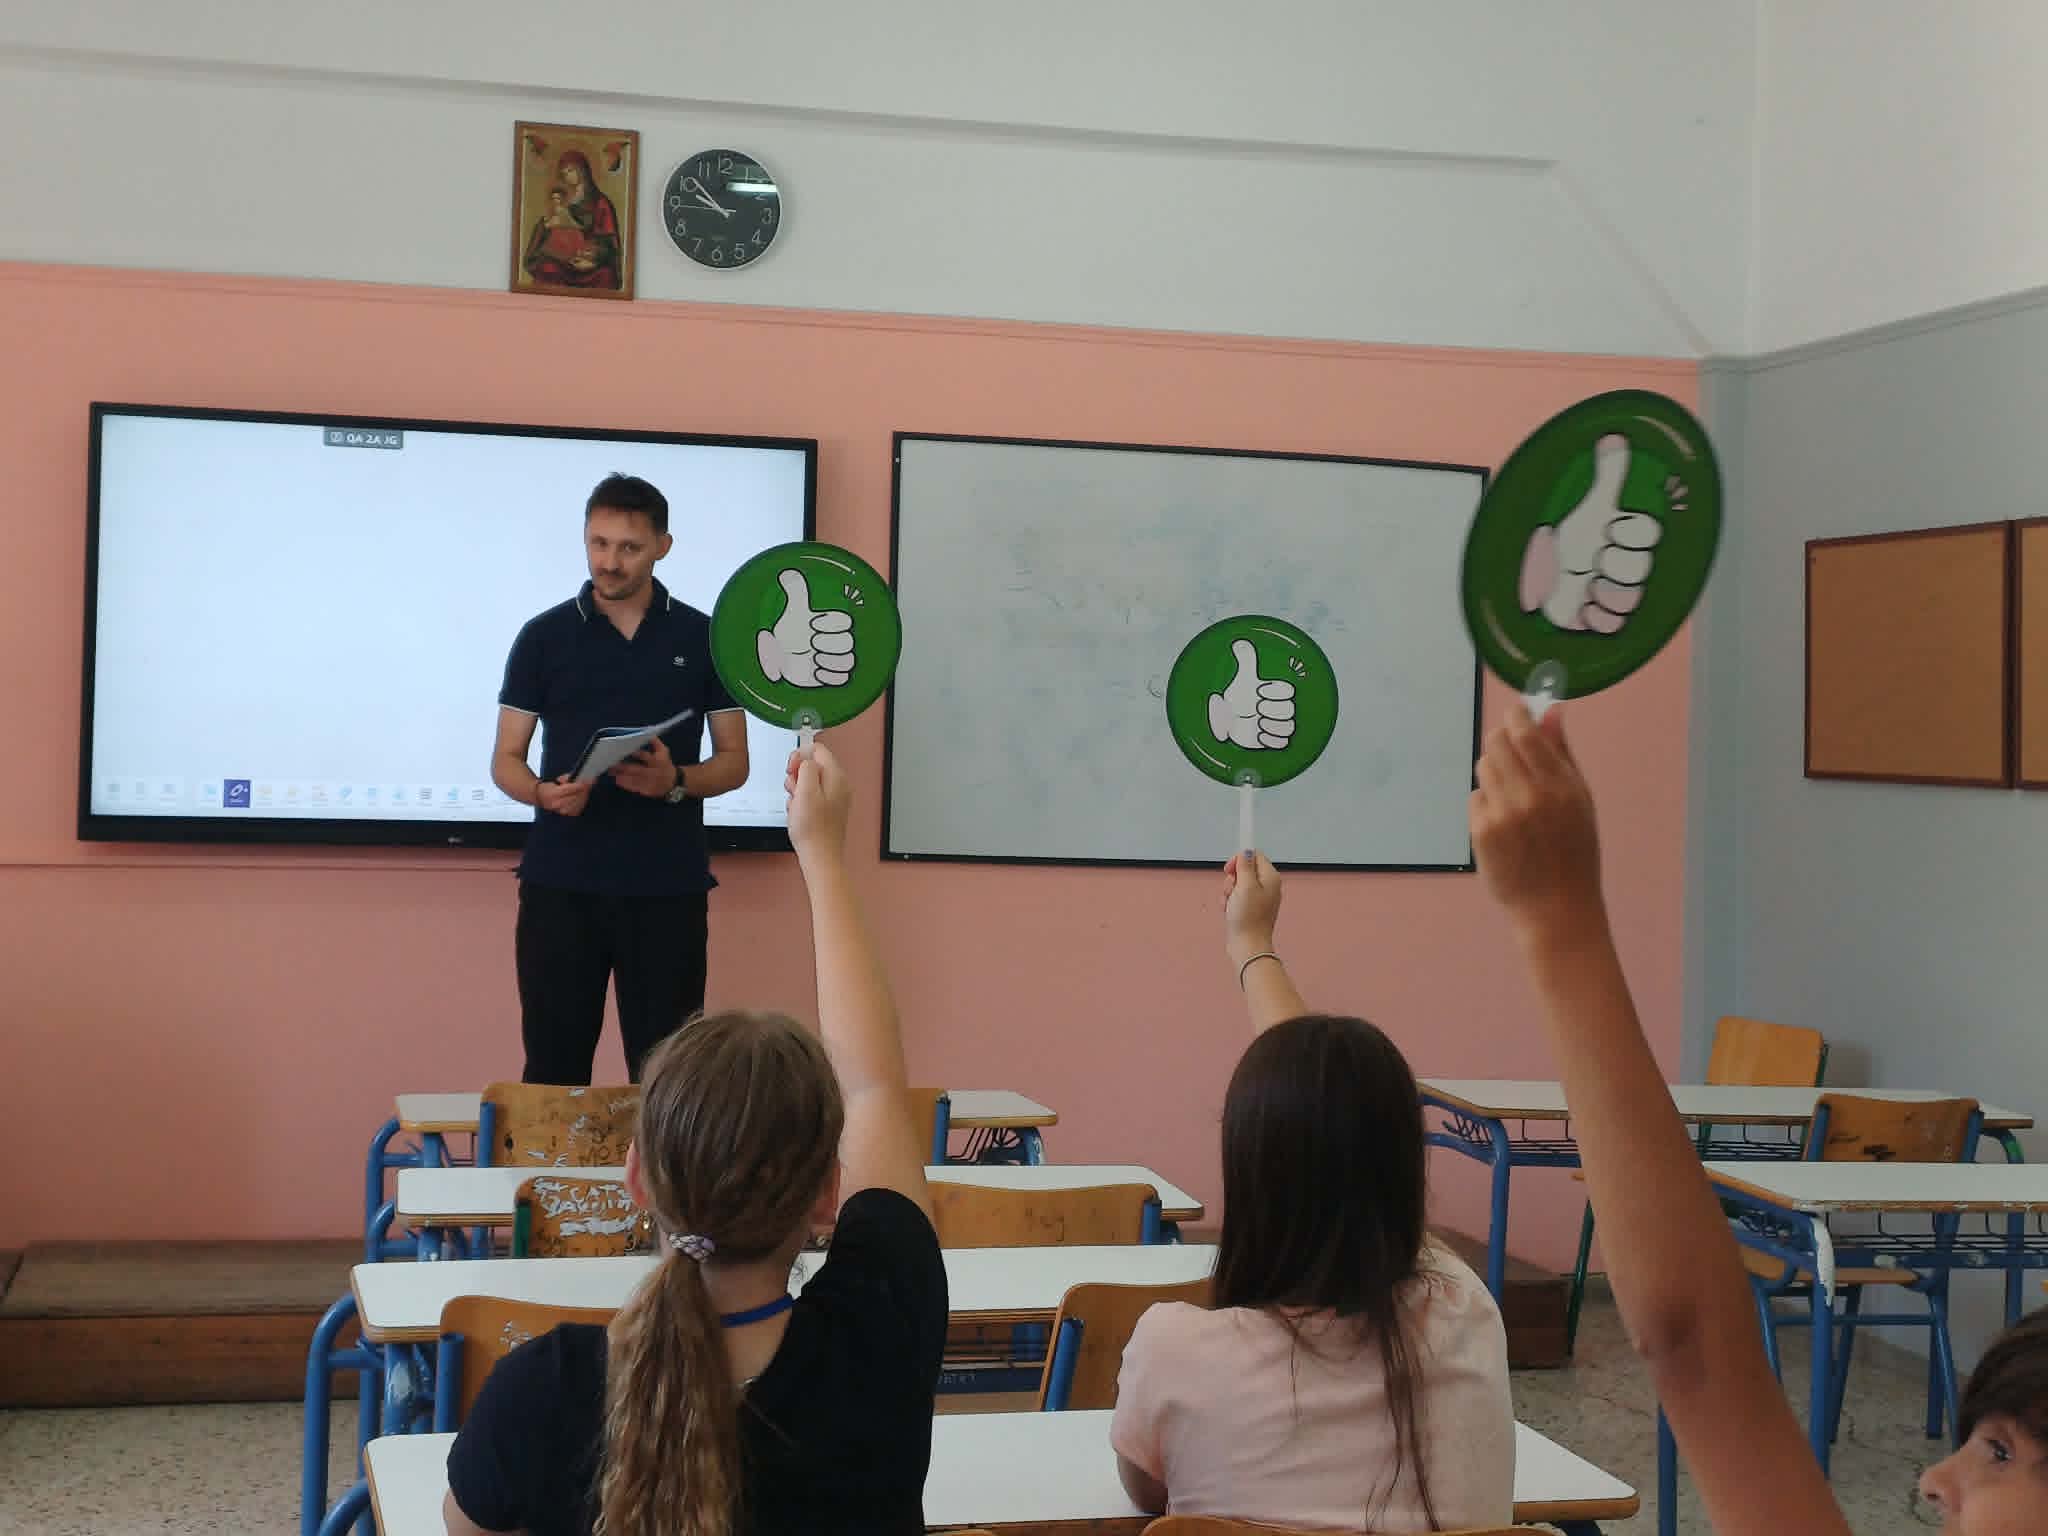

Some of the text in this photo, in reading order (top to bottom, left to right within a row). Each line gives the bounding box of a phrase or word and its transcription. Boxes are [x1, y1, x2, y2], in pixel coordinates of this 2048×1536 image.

[697, 158, 710, 177] 11
[718, 155, 734, 175] 12
[679, 175, 698, 192] 10
[670, 195, 681, 213] 9
[760, 207, 772, 224] 3
[675, 219, 686, 236] 8
[692, 237, 703, 253] 7
[752, 229, 761, 245] 4
[711, 246, 722, 262] 6
[734, 243, 745, 260] 5
